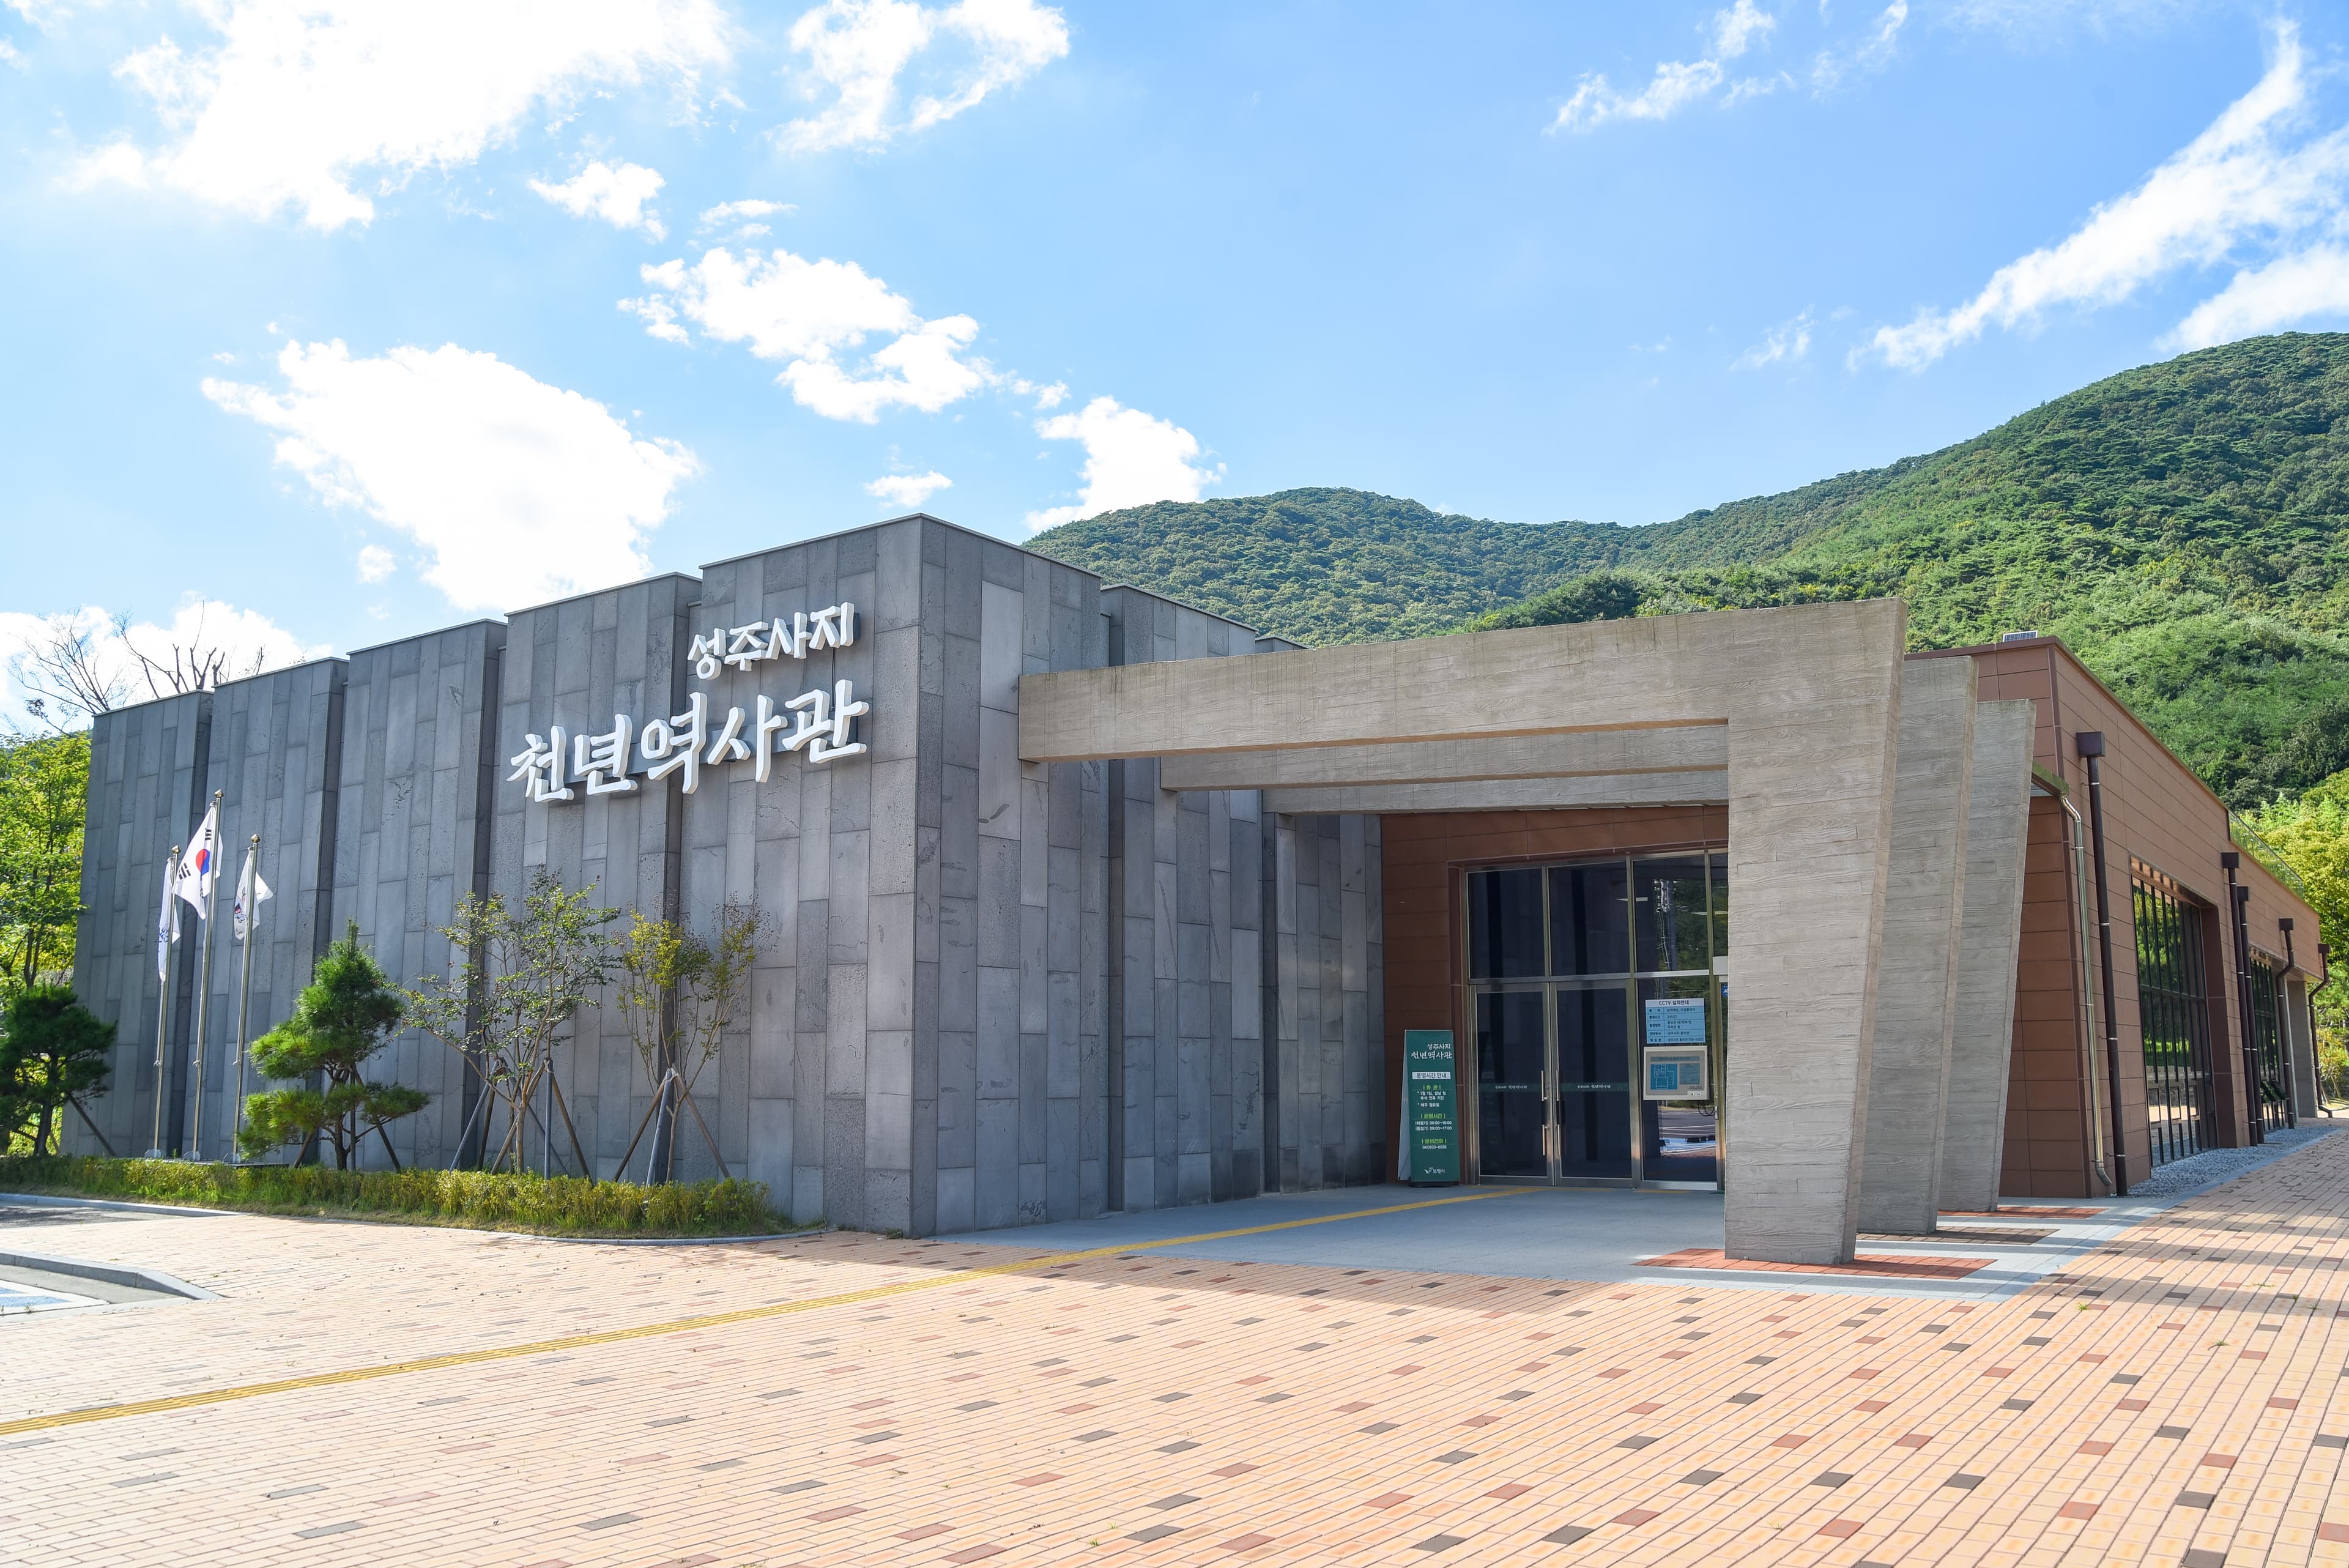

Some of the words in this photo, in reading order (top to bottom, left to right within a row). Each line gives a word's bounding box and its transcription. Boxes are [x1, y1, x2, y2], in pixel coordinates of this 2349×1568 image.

[687, 601, 855, 680] 성주사지
[506, 679, 869, 803] 천년역사관
[1411, 1050, 1452, 1060] 천년역사관
